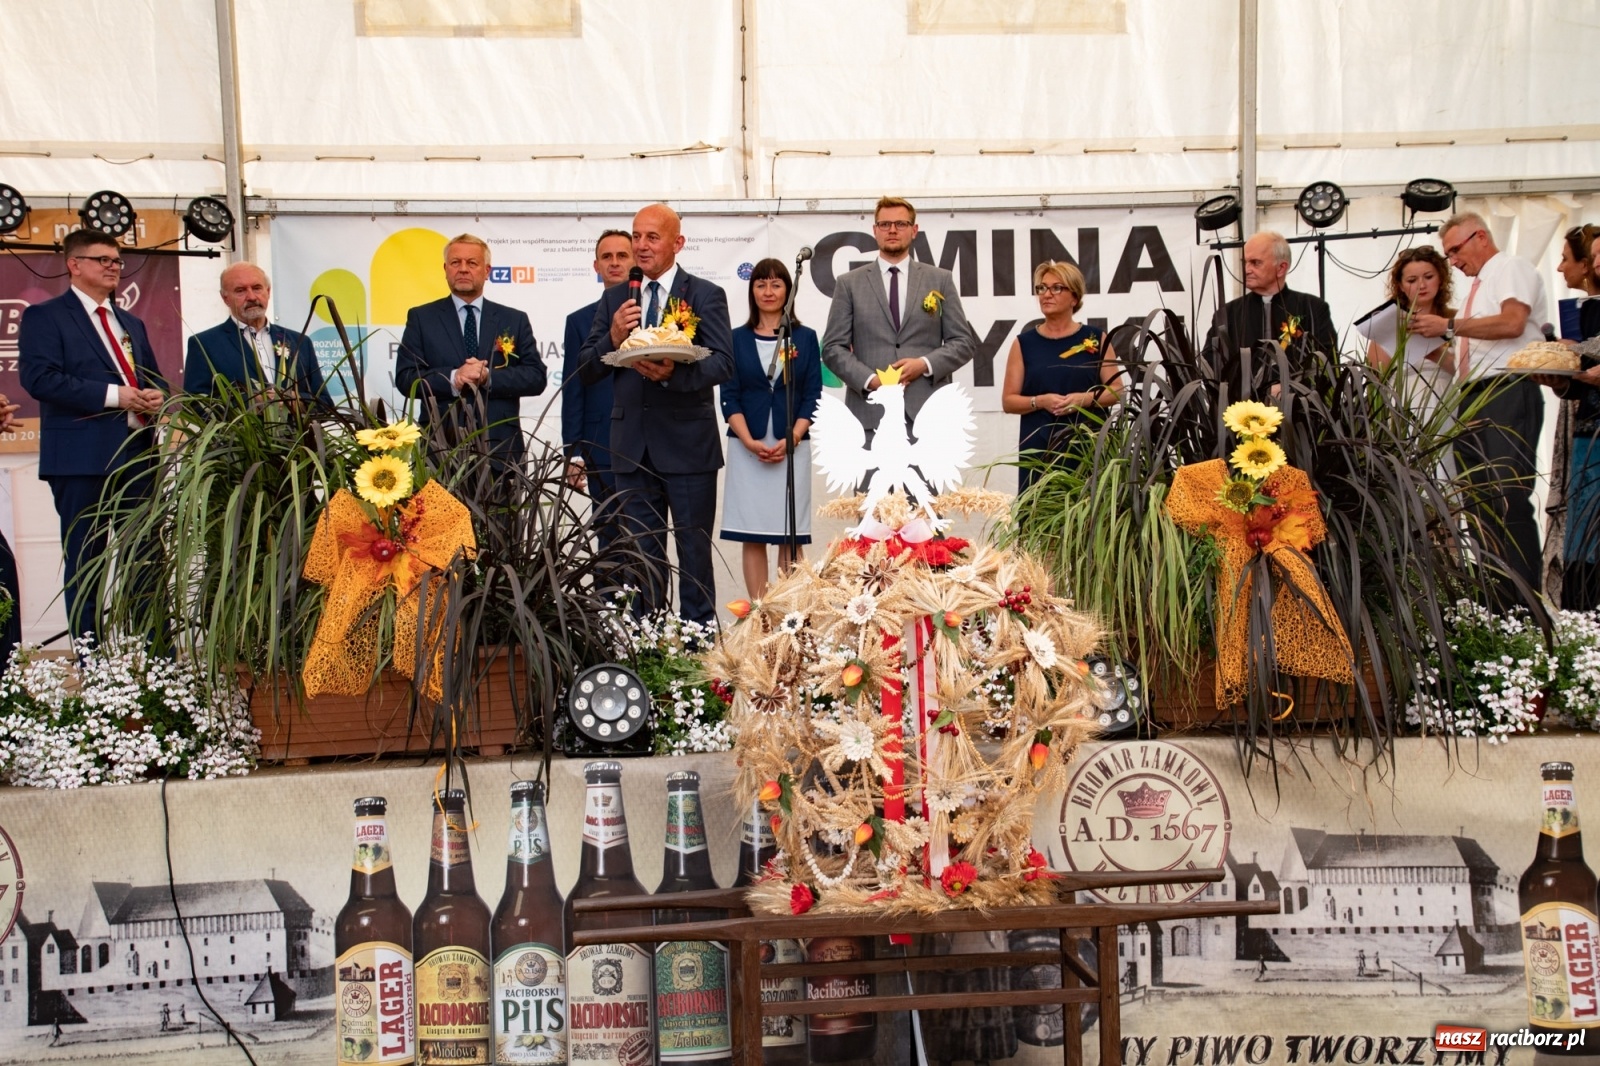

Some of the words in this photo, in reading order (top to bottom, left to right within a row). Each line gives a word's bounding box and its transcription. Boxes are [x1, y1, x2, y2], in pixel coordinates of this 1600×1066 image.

[714, 235, 755, 243] Regionalnego
[492, 269, 509, 281] cz
[516, 267, 531, 283] pl
[1070, 748, 1135, 810] BROWAR
[1140, 745, 1219, 806] ZAMKOWY
[1544, 790, 1573, 801] LAGER
[356, 824, 385, 837] LAGER
[1150, 807, 1218, 852] 1567
[606, 943, 636, 960] ZAMKOWY
[1565, 922, 1598, 1018] LAGER
[807, 979, 870, 1000] Raciborskie
[833, 979, 848, 987] Piwo
[505, 988, 559, 998] RACIBORSKI
[379, 960, 406, 1056] LAGER
[404, 972, 414, 1043] raciborski
[419, 1002, 490, 1026] RACIBORSKIE
[570, 1001, 649, 1029] RACIBORSKIE
[673, 1031, 712, 1048] Zielone
[431, 1041, 476, 1058] Miodowe
[1168, 1035, 1273, 1066] PIWO
